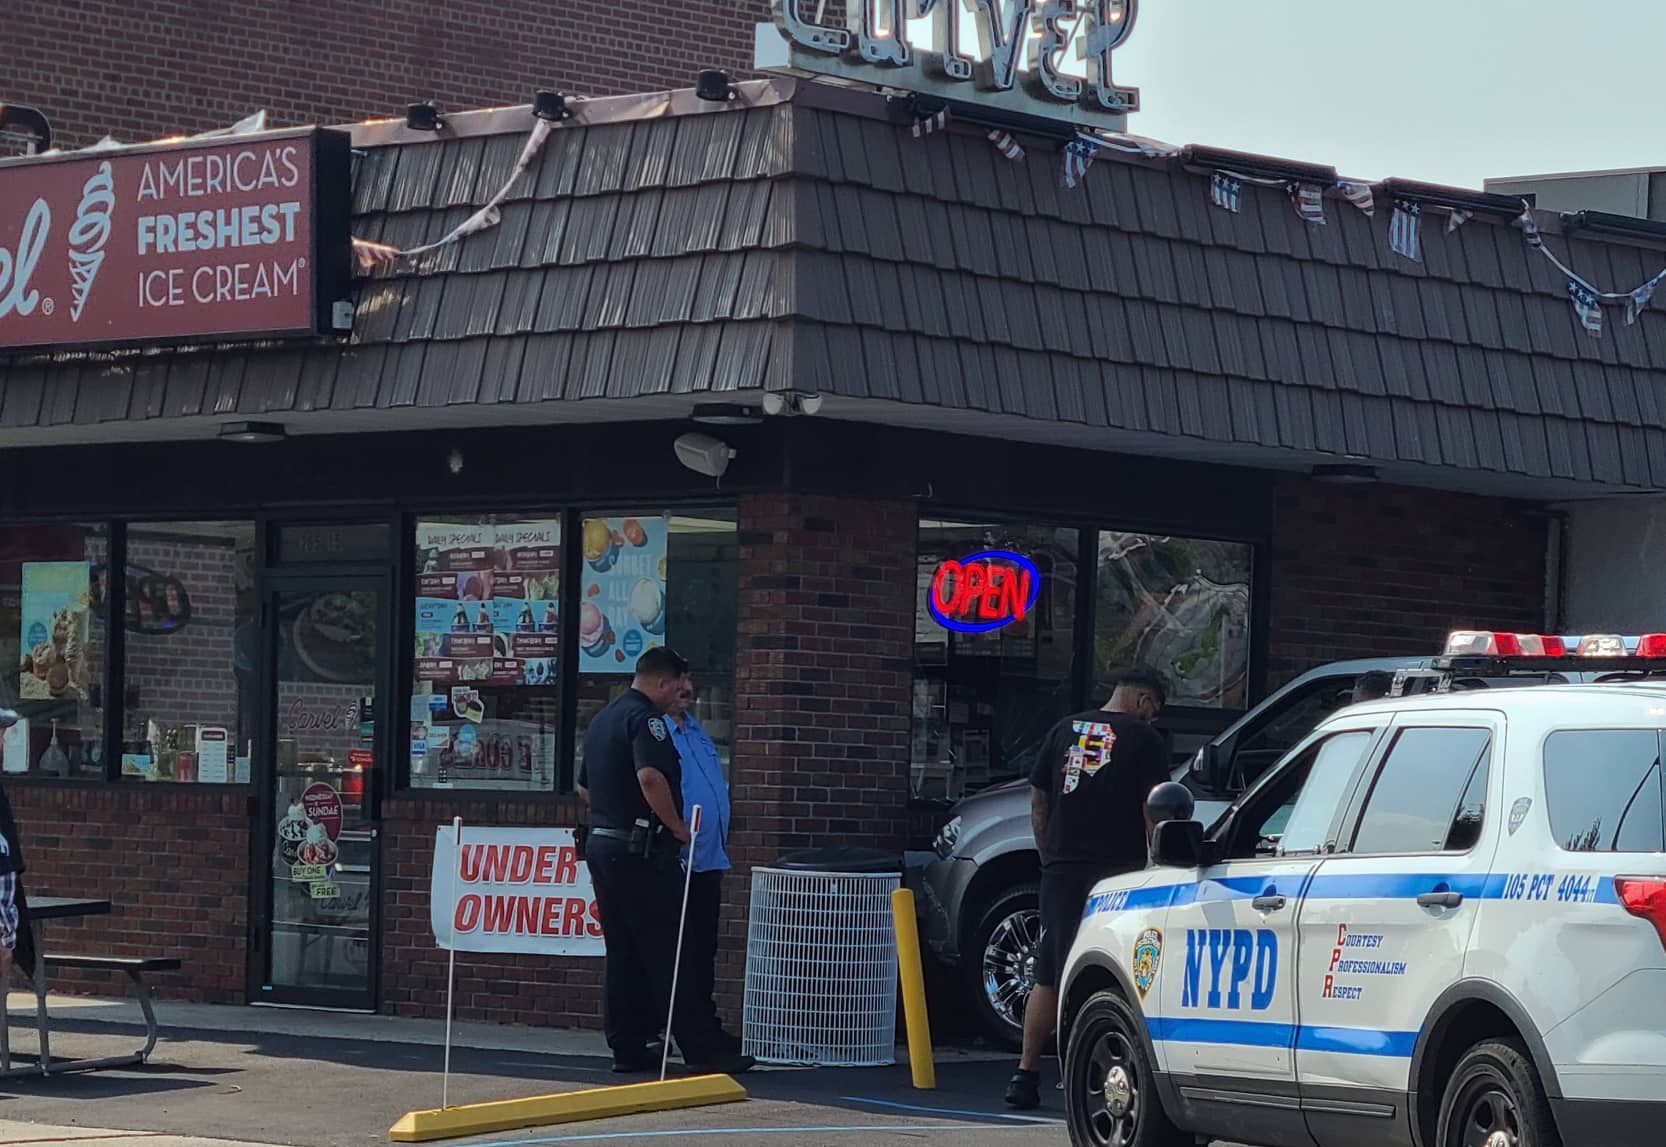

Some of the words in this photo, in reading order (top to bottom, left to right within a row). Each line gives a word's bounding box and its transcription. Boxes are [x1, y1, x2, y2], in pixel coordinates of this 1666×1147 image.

[137, 147, 299, 201] AMERICA'S
[137, 202, 300, 255] FRESHEST
[138, 269, 185, 307] ICE
[932, 560, 1030, 621] OPEN
[308, 805, 340, 817] SUNDAE
[293, 866, 305, 876] BUY
[306, 866, 321, 874] ONE
[459, 843, 578, 884] UNDER
[316, 886, 337, 896] FREE
[1097, 890, 1129, 912] POLICE
[1504, 874, 1528, 900] 105
[1527, 874, 1555, 900] PCT
[1557, 875, 1592, 902] 4044
[1337, 923, 1384, 948] COURTESY
[1181, 928, 1279, 1011] NYPD
[1328, 948, 1407, 975] PROFESSIONALISM
[1322, 975, 1363, 1000] RESPECT
